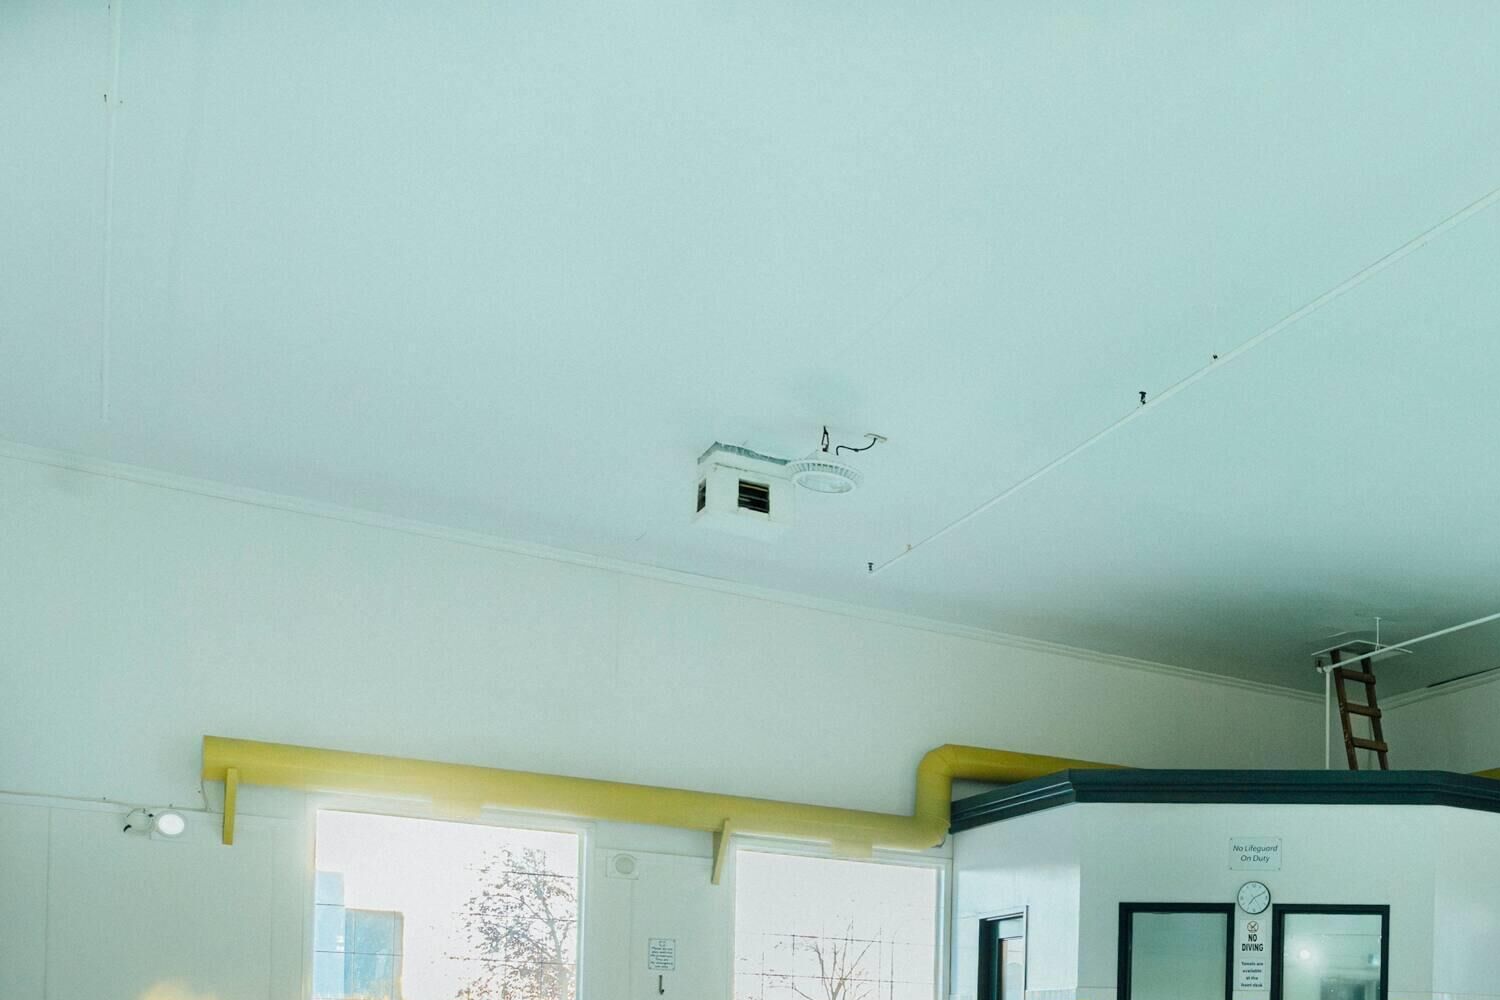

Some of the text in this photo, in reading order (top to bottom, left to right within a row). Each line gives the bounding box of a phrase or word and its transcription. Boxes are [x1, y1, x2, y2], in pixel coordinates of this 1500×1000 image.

[1232, 844, 1244, 852] No
[1240, 854, 1270, 864] On Duty
[1248, 934, 1258, 942] NO
[1242, 944, 1264, 952] DIVING
